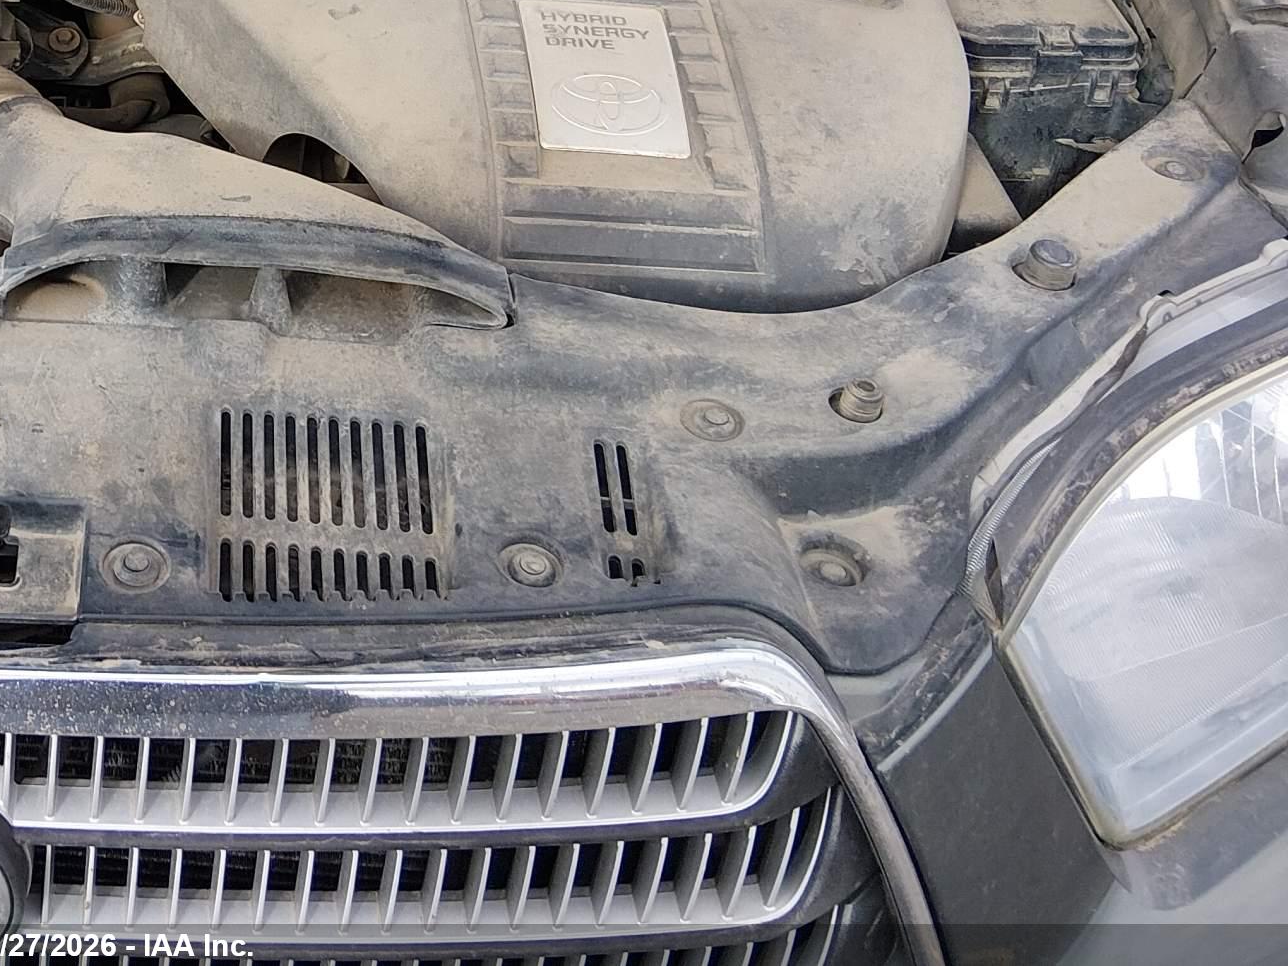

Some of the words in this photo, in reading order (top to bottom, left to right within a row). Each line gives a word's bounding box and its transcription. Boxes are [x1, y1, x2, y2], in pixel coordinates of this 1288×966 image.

[539, 11, 627, 27] HYBRID
[541, 23, 650, 40] SYNERGY
[544, 36, 616, 50] DRIVE
